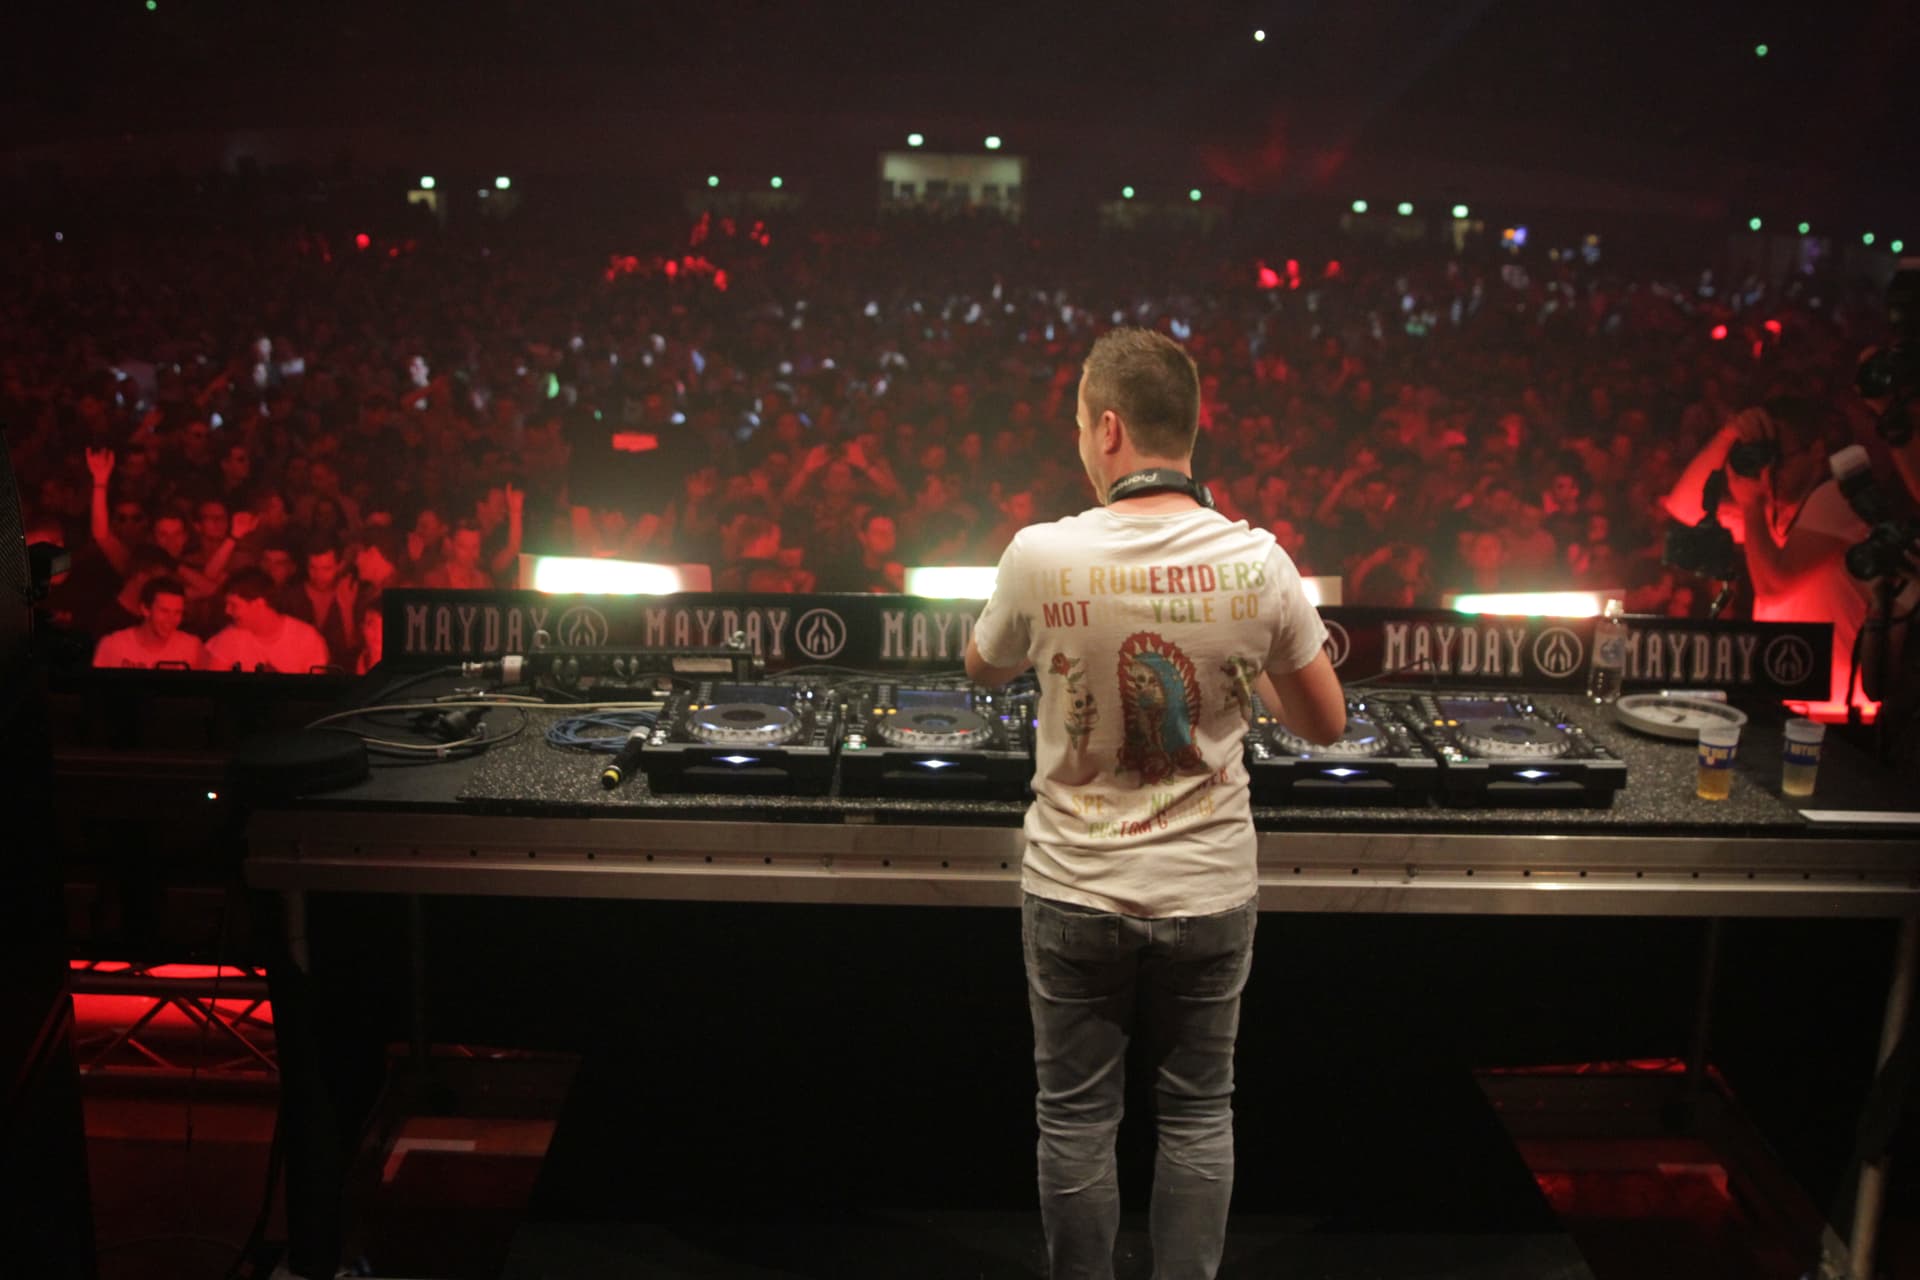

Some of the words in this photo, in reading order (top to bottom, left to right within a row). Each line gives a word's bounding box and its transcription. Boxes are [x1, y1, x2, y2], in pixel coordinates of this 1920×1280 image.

[405, 604, 549, 652] MAYDAY
[645, 606, 789, 658] MAYDAY
[1231, 593, 1259, 621] CO
[880, 609, 979, 659] MAYD
[1383, 622, 1528, 675] MAYDAY
